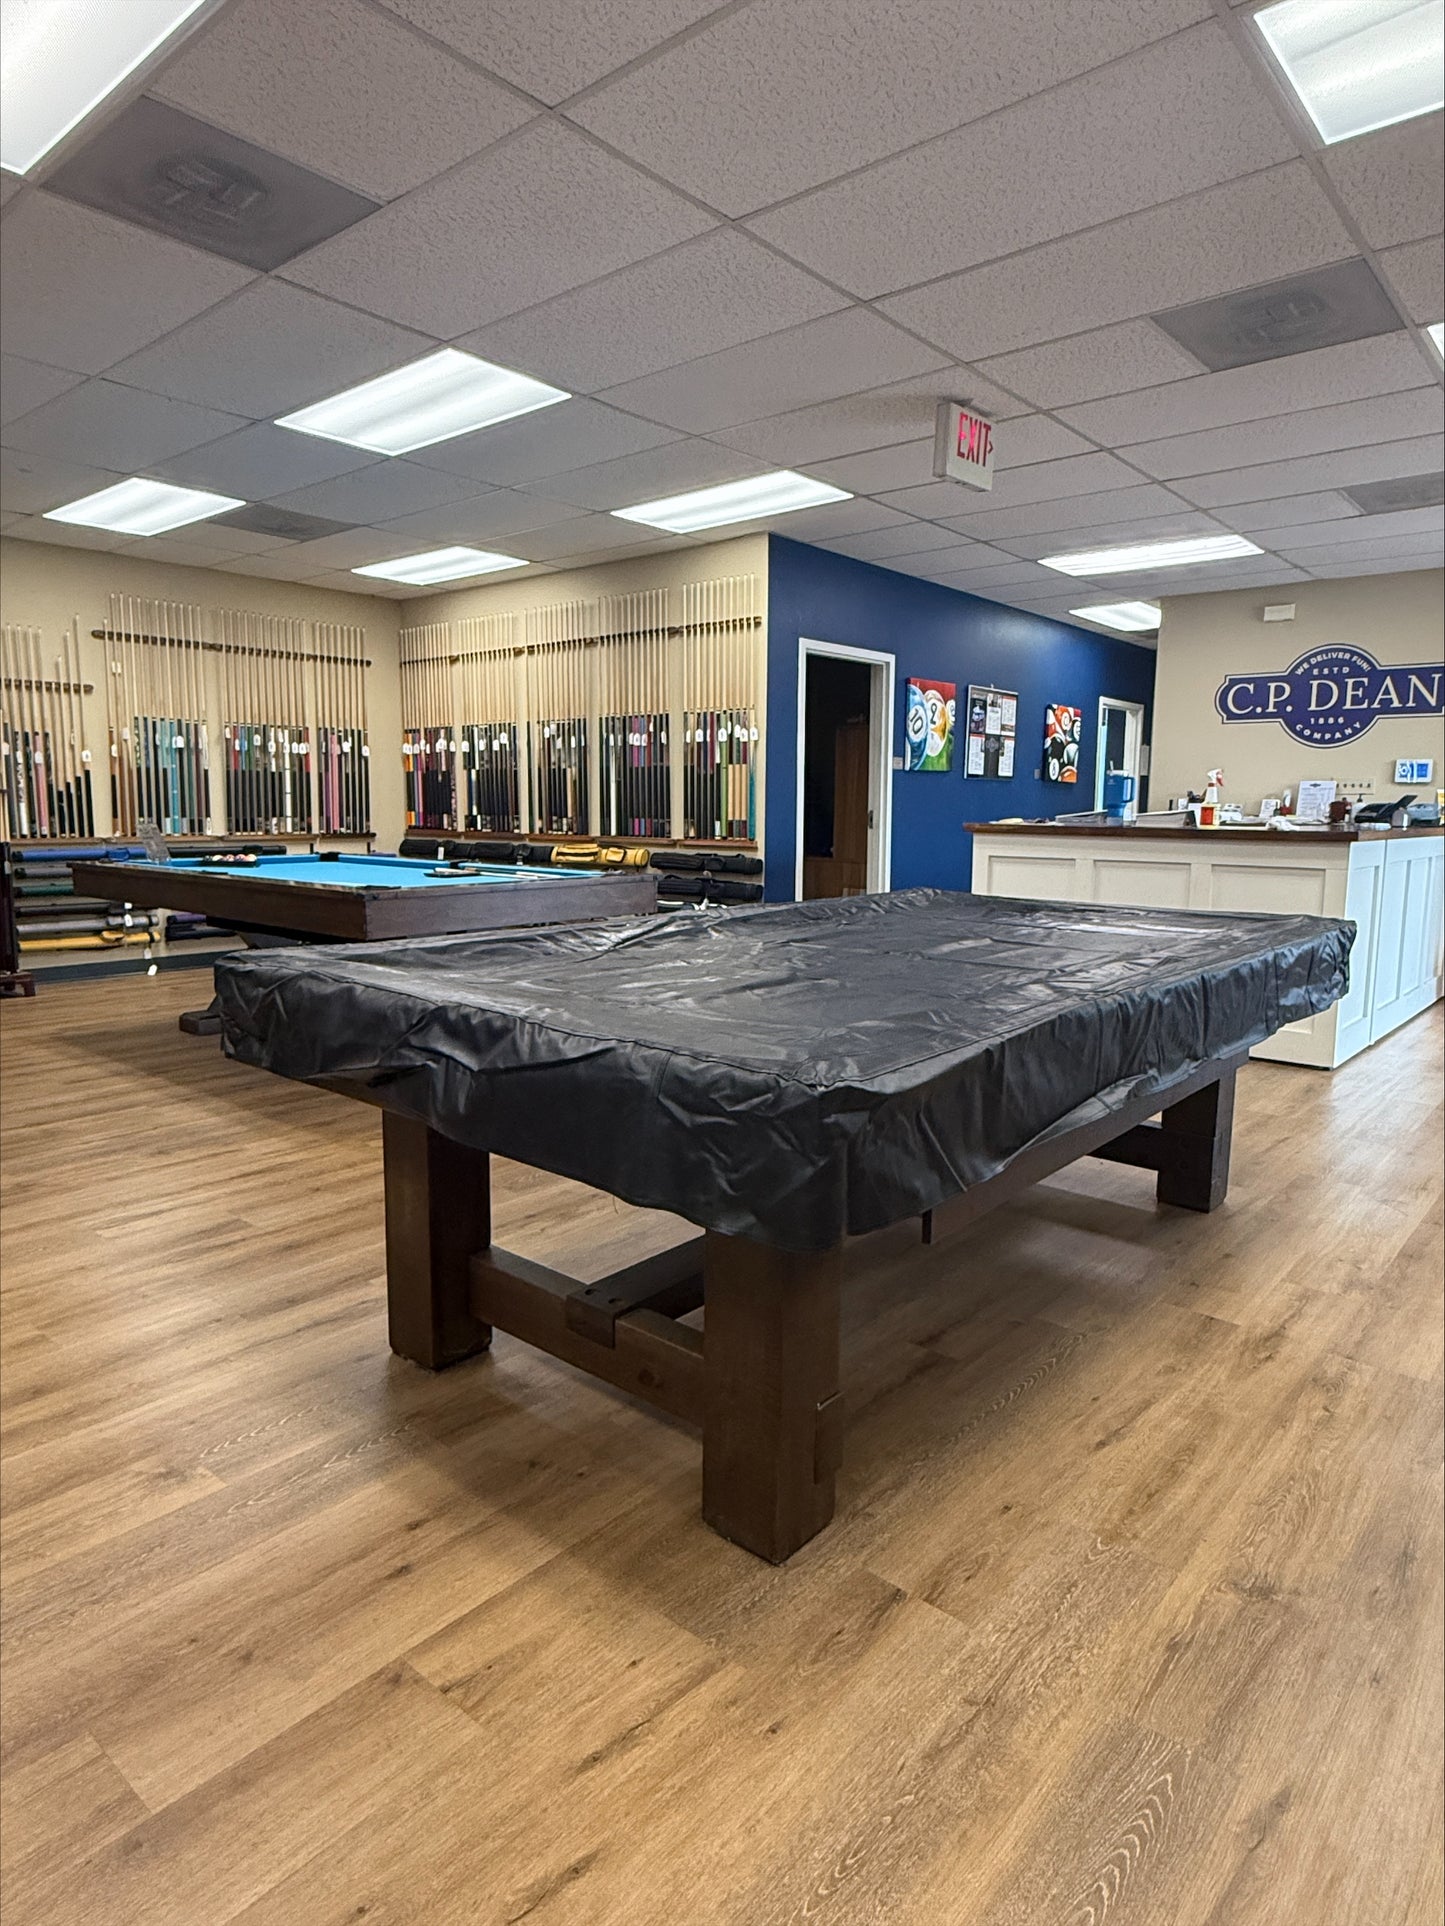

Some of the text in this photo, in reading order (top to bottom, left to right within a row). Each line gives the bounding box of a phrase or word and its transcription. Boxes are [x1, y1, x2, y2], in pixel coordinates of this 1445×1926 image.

[957, 411, 992, 467] EXIT
[1294, 652, 1372, 676] WE DELIVER FUN!
[1312, 666, 1350, 675] ESTD
[1226, 673, 1442, 715] C.P. DEAN
[910, 708, 923, 735] 10
[1295, 721, 1361, 740] COMPANY
[1310, 716, 1345, 725] 1886
